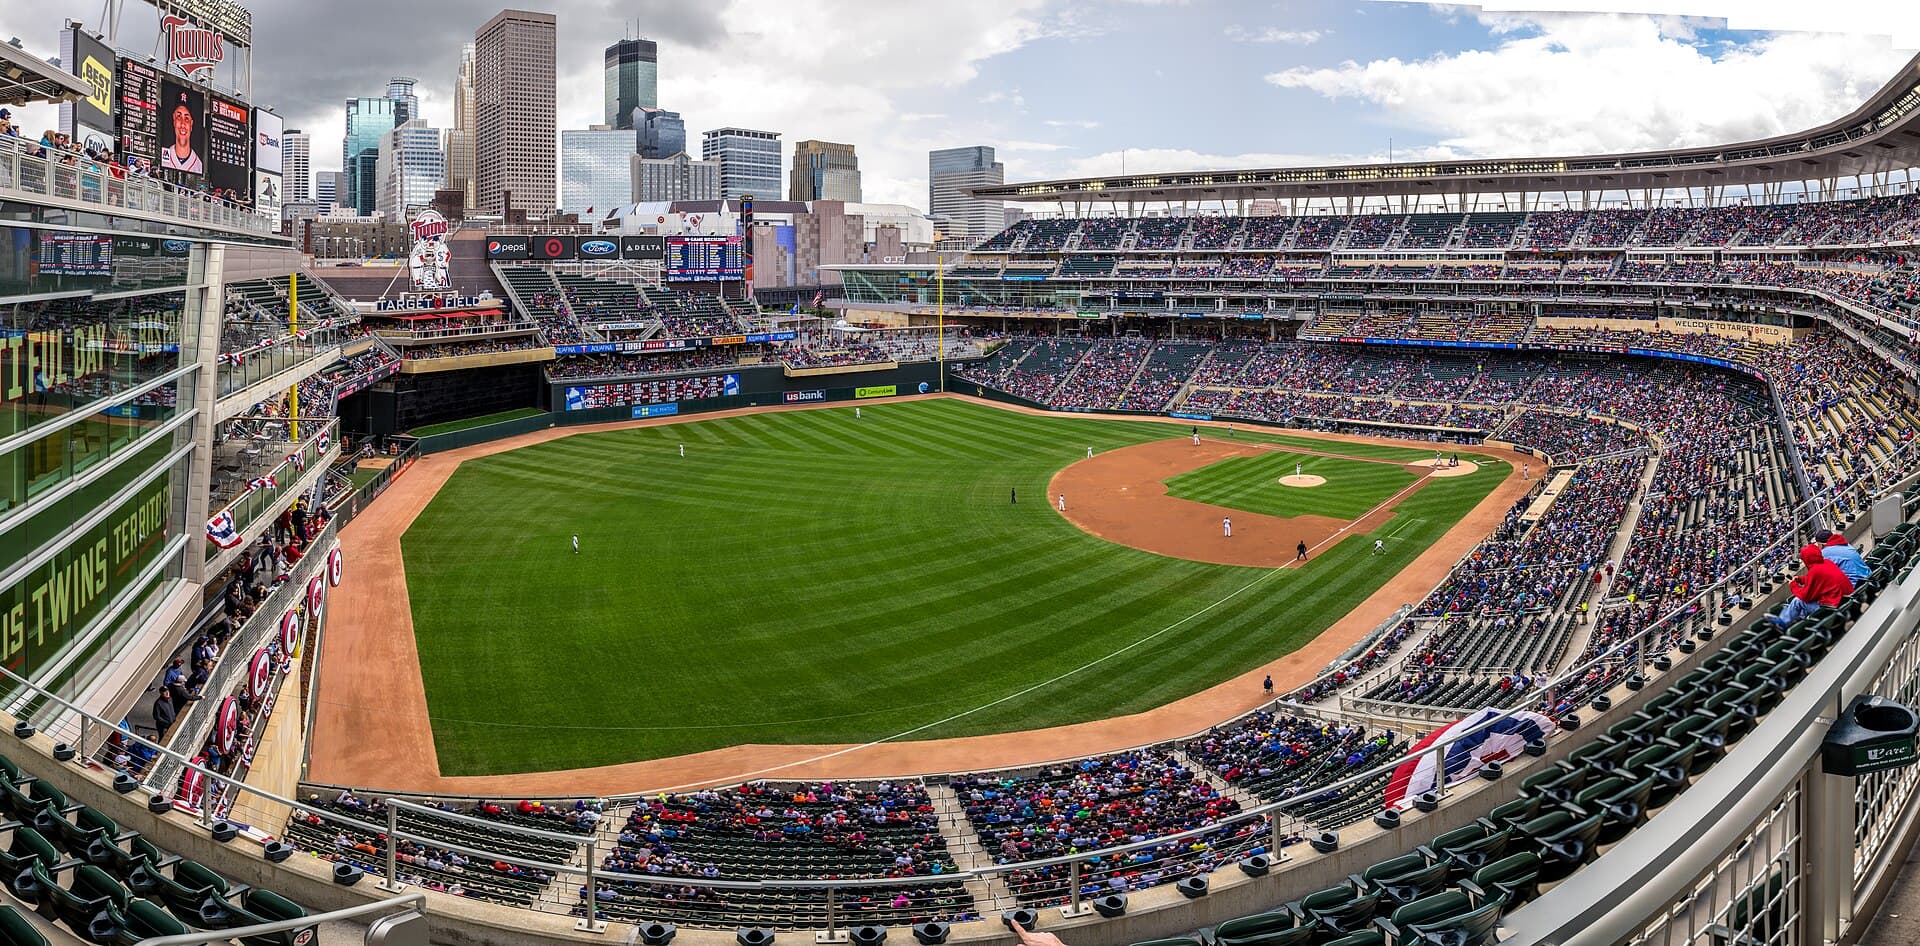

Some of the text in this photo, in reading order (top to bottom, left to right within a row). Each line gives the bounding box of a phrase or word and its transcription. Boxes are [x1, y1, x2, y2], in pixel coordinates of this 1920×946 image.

[162, 14, 224, 63] Twins
[86, 63, 111, 92] BEST
[410, 220, 448, 242] Twins
[501, 243, 526, 252] pepsi
[587, 244, 610, 252] Ford
[378, 296, 481, 312] TARGET FIELD
[1674, 320, 1714, 329] WELCOME
[1727, 324, 1755, 332] TARGET
[1759, 327, 1779, 336] FIELD
[74, 322, 107, 379] DAY
[3, 537, 108, 661] IS TWINS
